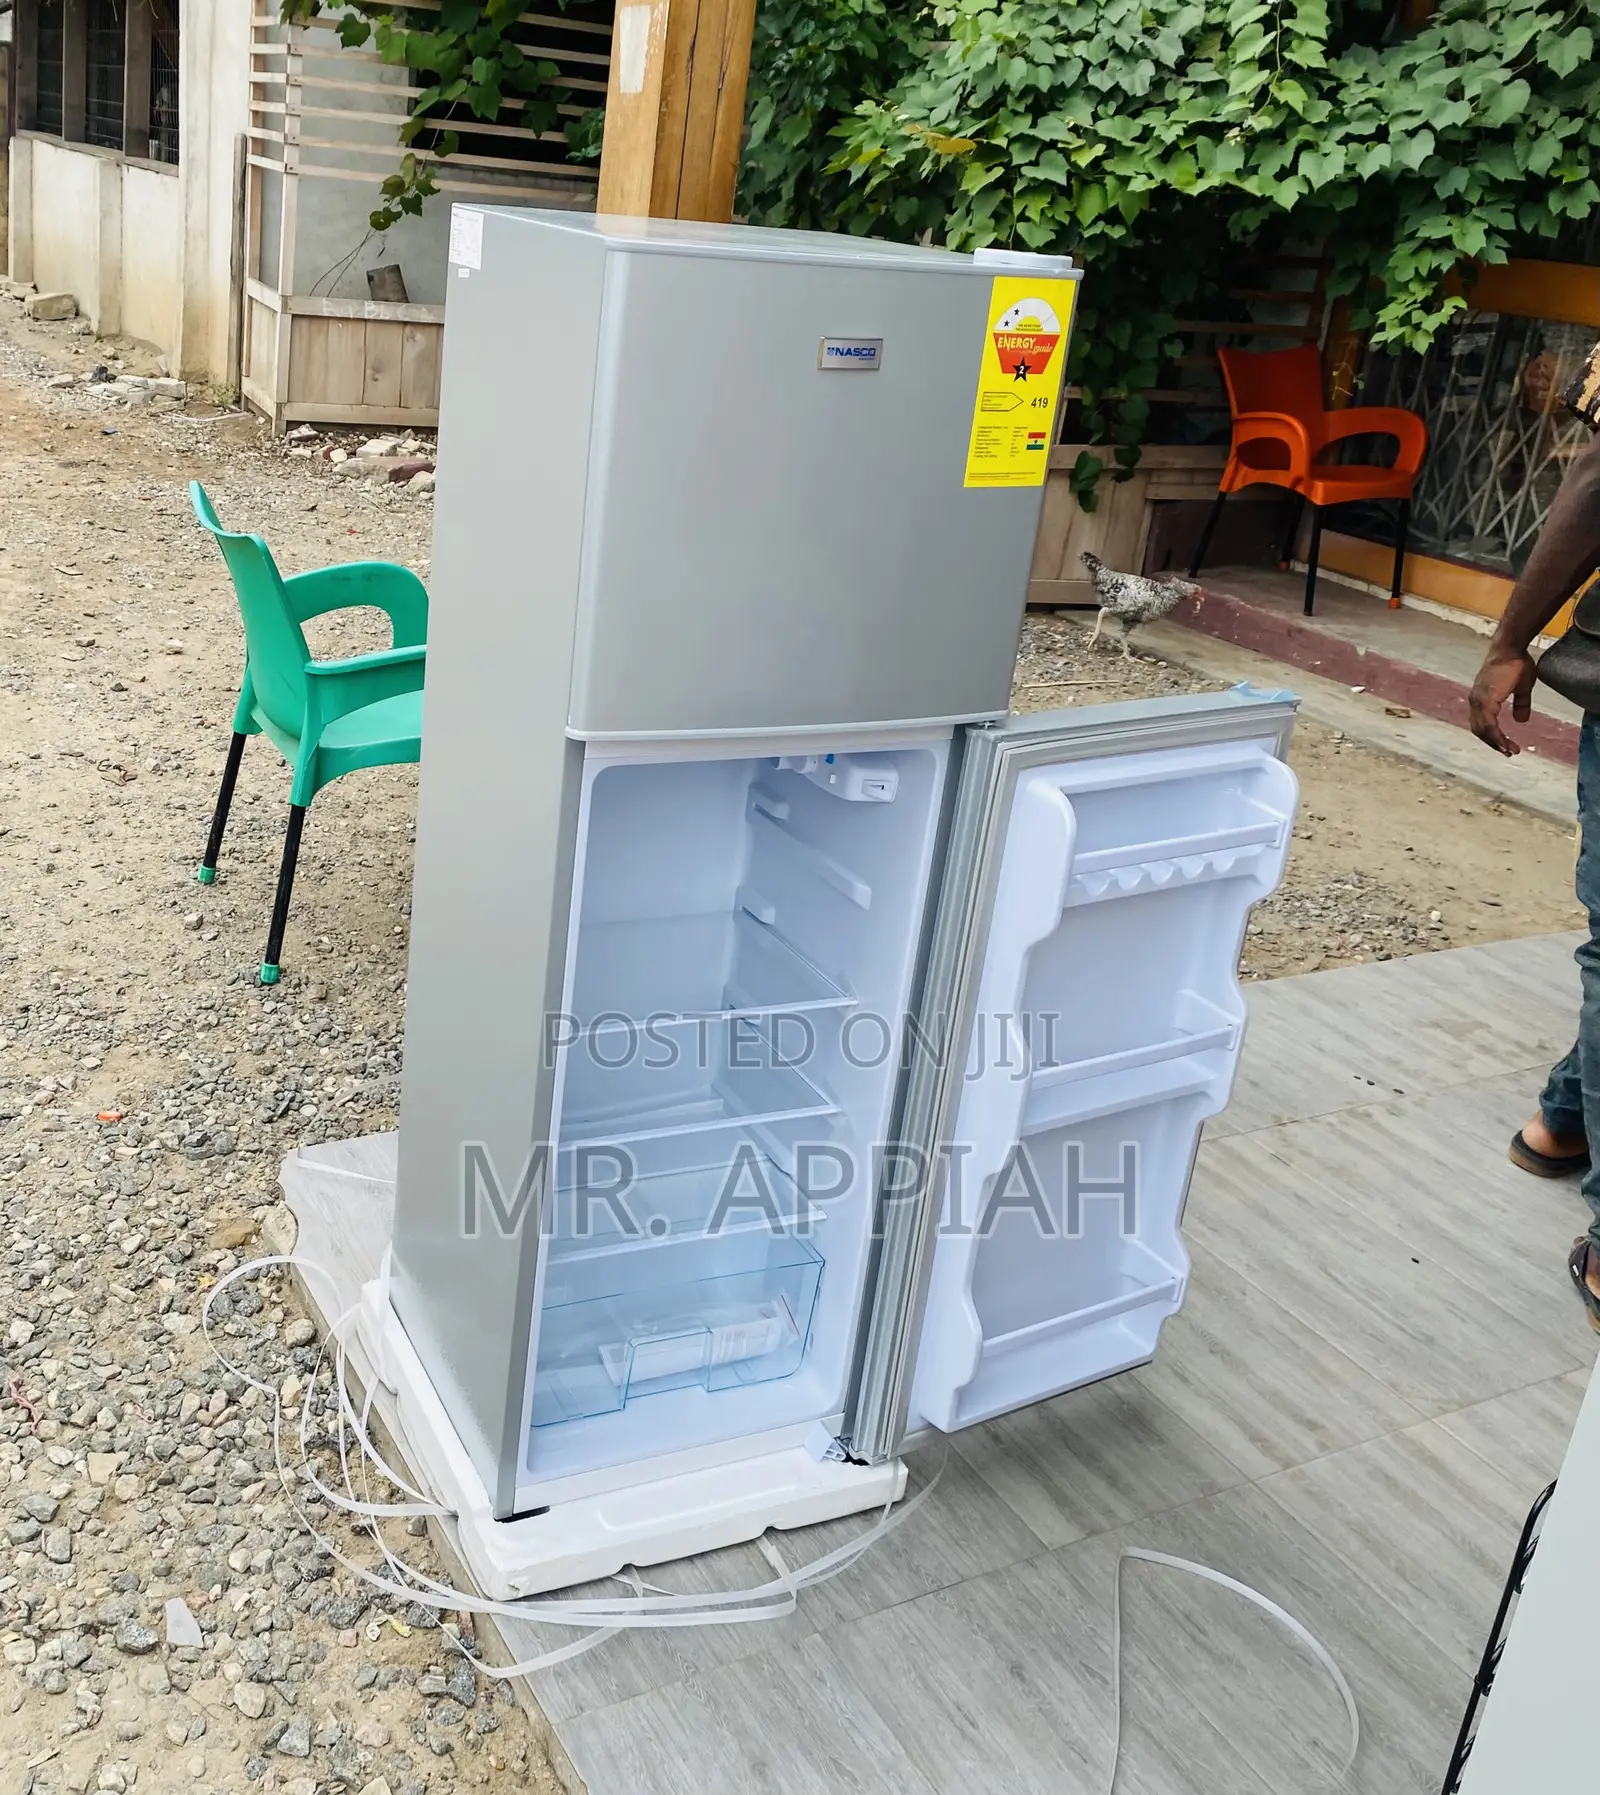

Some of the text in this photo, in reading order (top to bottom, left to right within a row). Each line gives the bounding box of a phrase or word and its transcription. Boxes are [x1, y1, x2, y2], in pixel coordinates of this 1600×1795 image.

[997, 334, 1053, 355] ENERGY guide
[834, 347, 876, 357] NASCO
[1019, 365, 1025, 374] 2
[1031, 397, 1049, 408] 419
